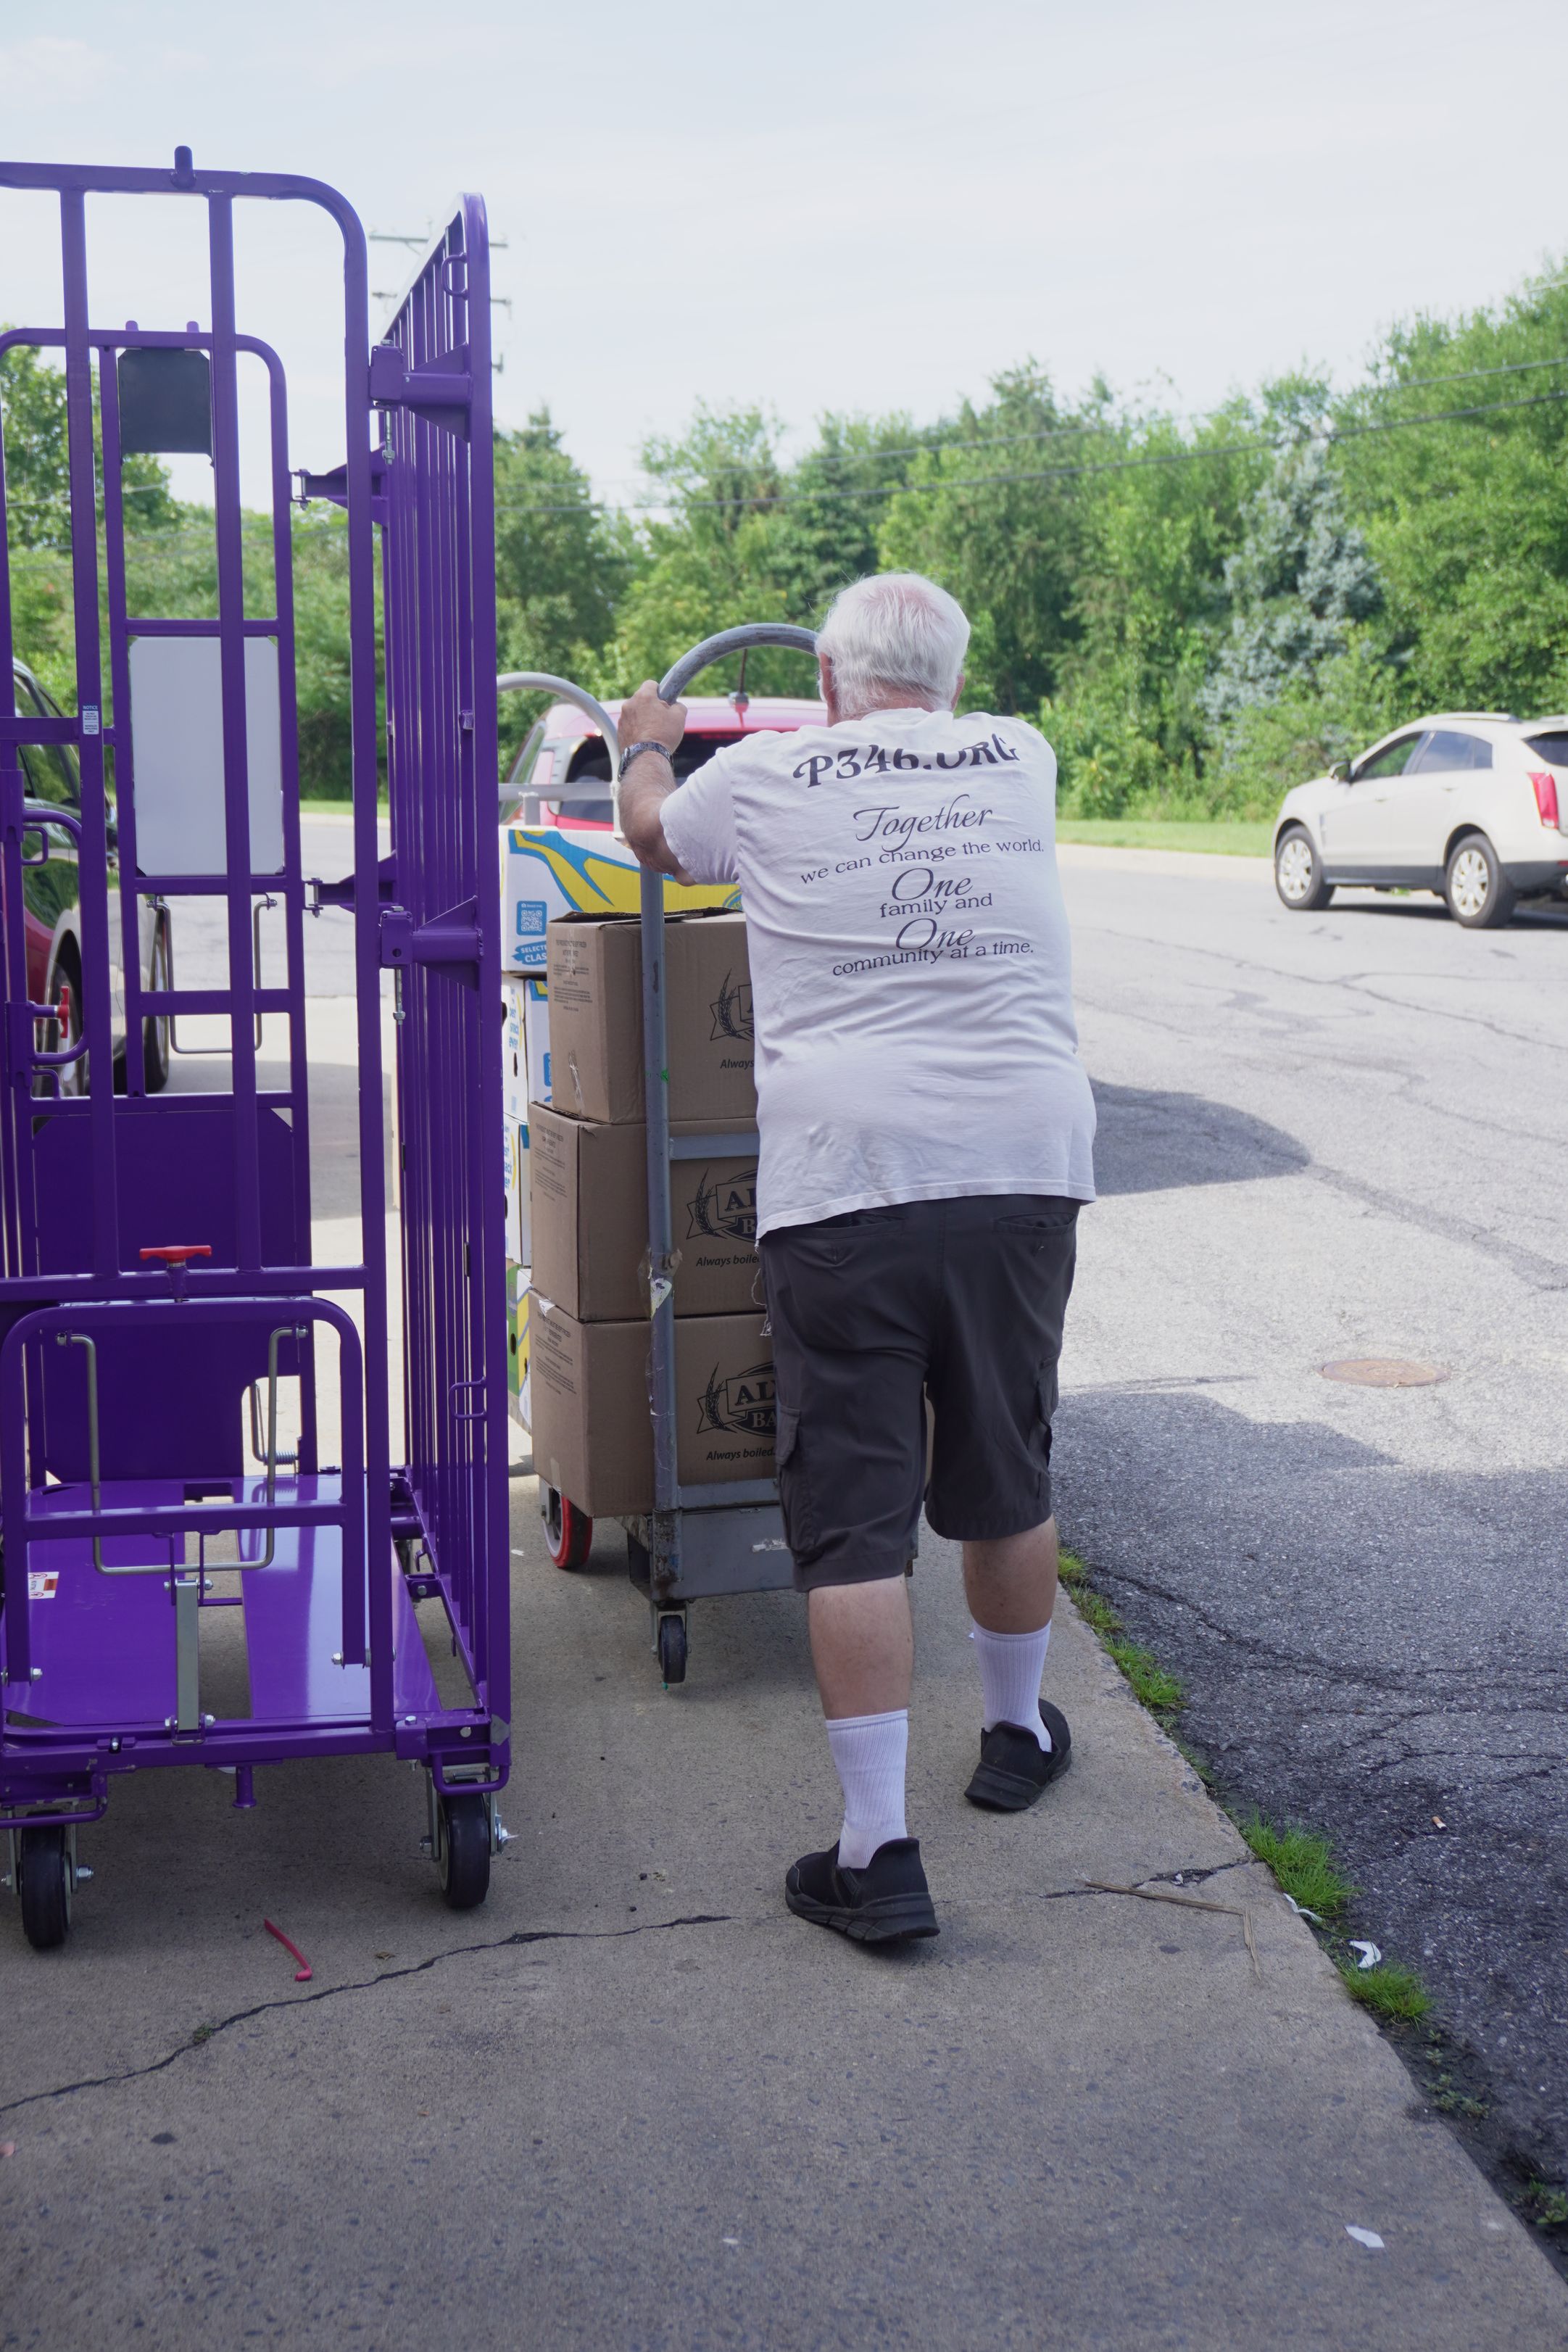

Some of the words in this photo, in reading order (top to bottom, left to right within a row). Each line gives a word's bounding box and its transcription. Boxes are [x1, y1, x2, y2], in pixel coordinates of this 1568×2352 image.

[853, 794, 993, 853] Together
[800, 868, 829, 885] we
[835, 857, 872, 874] can
[879, 845, 957, 865] change
[963, 841, 992, 856] the
[996, 838, 1045, 853] world.
[891, 867, 974, 901] One
[879, 898, 947, 918] family
[955, 893, 993, 909] and
[895, 918, 976, 951] One
[832, 950, 944, 976] community
[950, 945, 968, 959] at
[975, 947, 987, 956] a
[992, 940, 1034, 955] time.
[719, 1059, 755, 1070] Always
[695, 1256, 731, 1267] Always
[706, 1450, 741, 1462] Always
